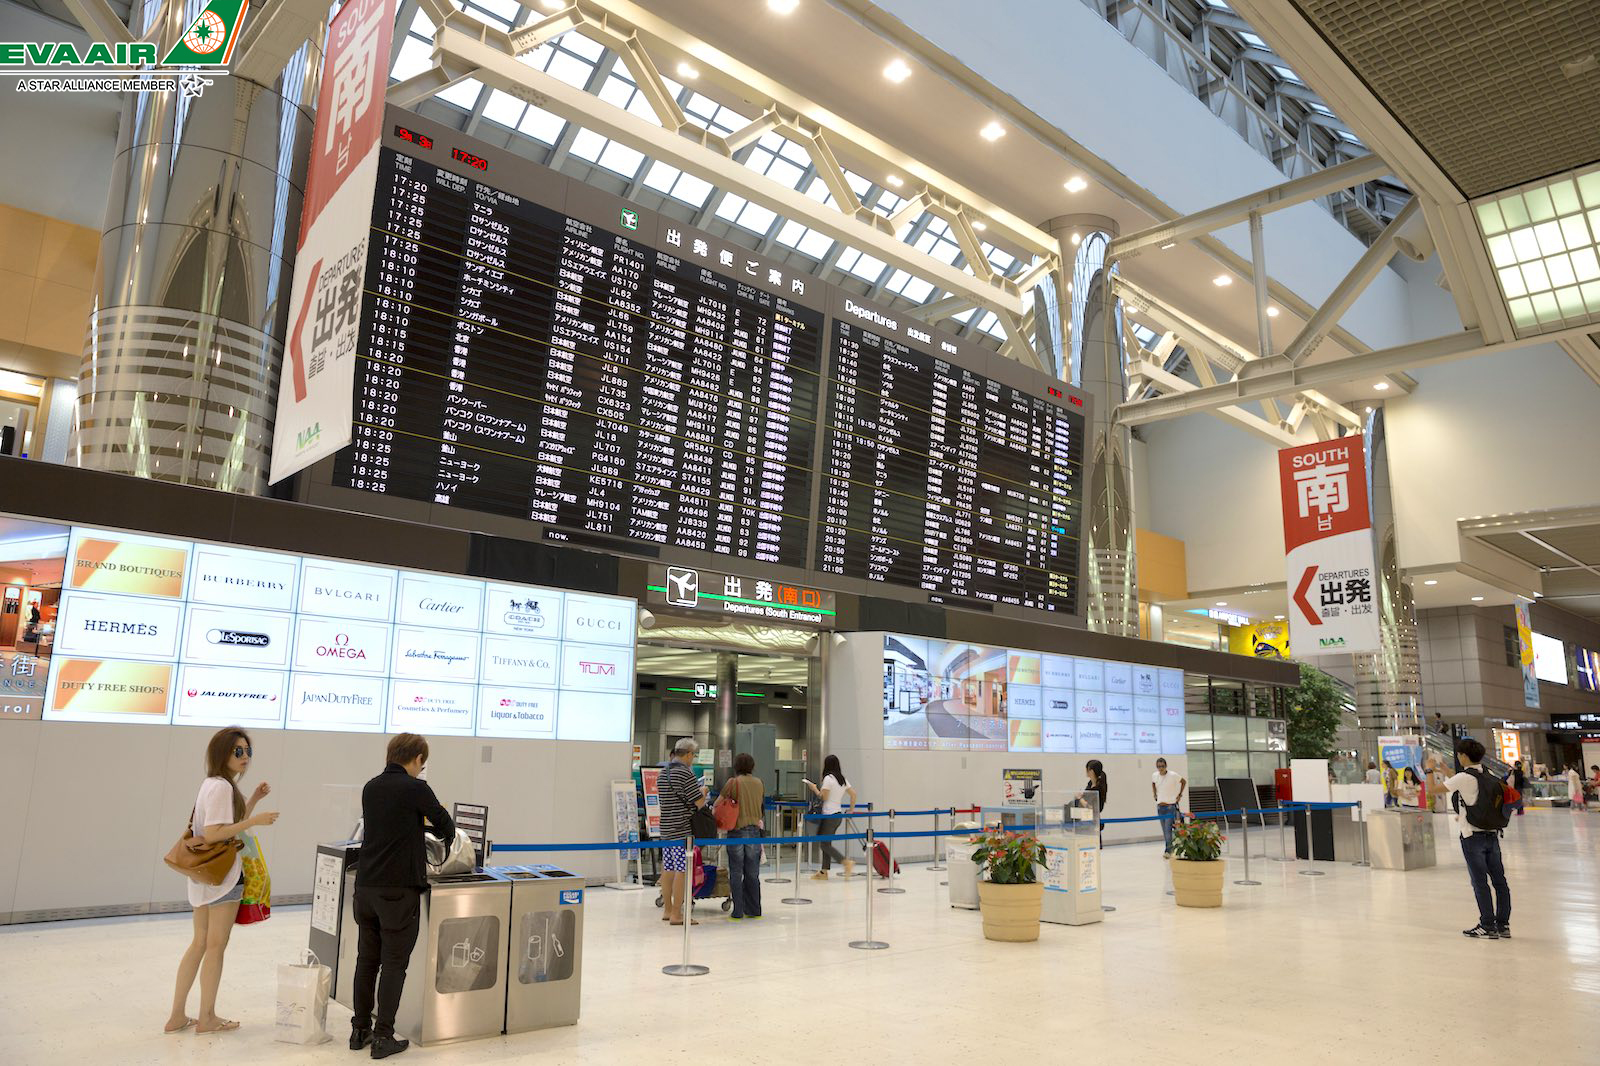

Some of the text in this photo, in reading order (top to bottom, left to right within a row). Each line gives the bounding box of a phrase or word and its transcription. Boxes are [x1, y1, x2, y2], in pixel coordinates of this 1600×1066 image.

[326, 0, 385, 156] 南
[452, 148, 486, 170] 17:20
[395, 160, 412, 173] TIME
[475, 191, 498, 205] TO/VIA
[391, 198, 424, 216] 17:25
[470, 226, 508, 245] ロサンゼルス
[395, 174, 427, 192] 17:20
[474, 203, 492, 215] マニラ
[613, 254, 644, 271] PR1401
[386, 235, 418, 252] 17:25
[393, 186, 767, 326] 17:25 ロサンゼルス AA170 72
[318, 238, 366, 292] DEPARTURES
[666, 228, 805, 296] 出発便ご案内
[382, 260, 415, 276] 18:10
[605, 330, 632, 343] AA154
[384, 248, 417, 264] 18:00
[607, 319, 633, 333] JL759
[610, 287, 631, 299] JL62
[311, 264, 362, 353] 出発
[377, 298, 410, 314] 18:10
[844, 299, 898, 332] Departures
[379, 284, 412, 301] 18:10
[603, 352, 629, 365] JL711
[371, 335, 405, 351] 18:15
[373, 323, 626, 398] 18:15 JL735
[369, 348, 624, 420] 18:20 CX505
[366, 374, 399, 389] 18:20
[595, 430, 616, 441] JL18
[358, 426, 393, 440] 18:20
[362, 400, 625, 466] 18:20 PG4160
[357, 439, 391, 453] 18:25
[589, 487, 605, 496] JL4
[1292, 446, 1349, 468] SOUTH
[353, 465, 387, 479] 18:25
[436, 482, 457, 492] ハノイ
[586, 510, 612, 521] JL751
[1293, 463, 1350, 518] 南
[351, 478, 611, 532] 18:25 JL811
[587, 498, 620, 511] MH9104
[548, 530, 569, 541] now.
[1318, 515, 1332, 532] 남
[76, 558, 182, 579] BRAND BOUTIQUES
[1318, 568, 1370, 582] DEPARTURES
[202, 574, 287, 590] BURBERRY
[314, 586, 380, 602] BVLGARI
[724, 576, 772, 602] 出発
[1320, 578, 1372, 606] 出発
[418, 596, 464, 614] Cartier
[724, 600, 822, 624] Departures (South Entrance)
[576, 616, 622, 631] GUCCI
[316, 646, 366, 660] OMEGA
[1319, 636, 1346, 648] NAA
[61, 680, 164, 695] DUTY FREE SHOPS
[398, 705, 429, 714] Cosmetics
